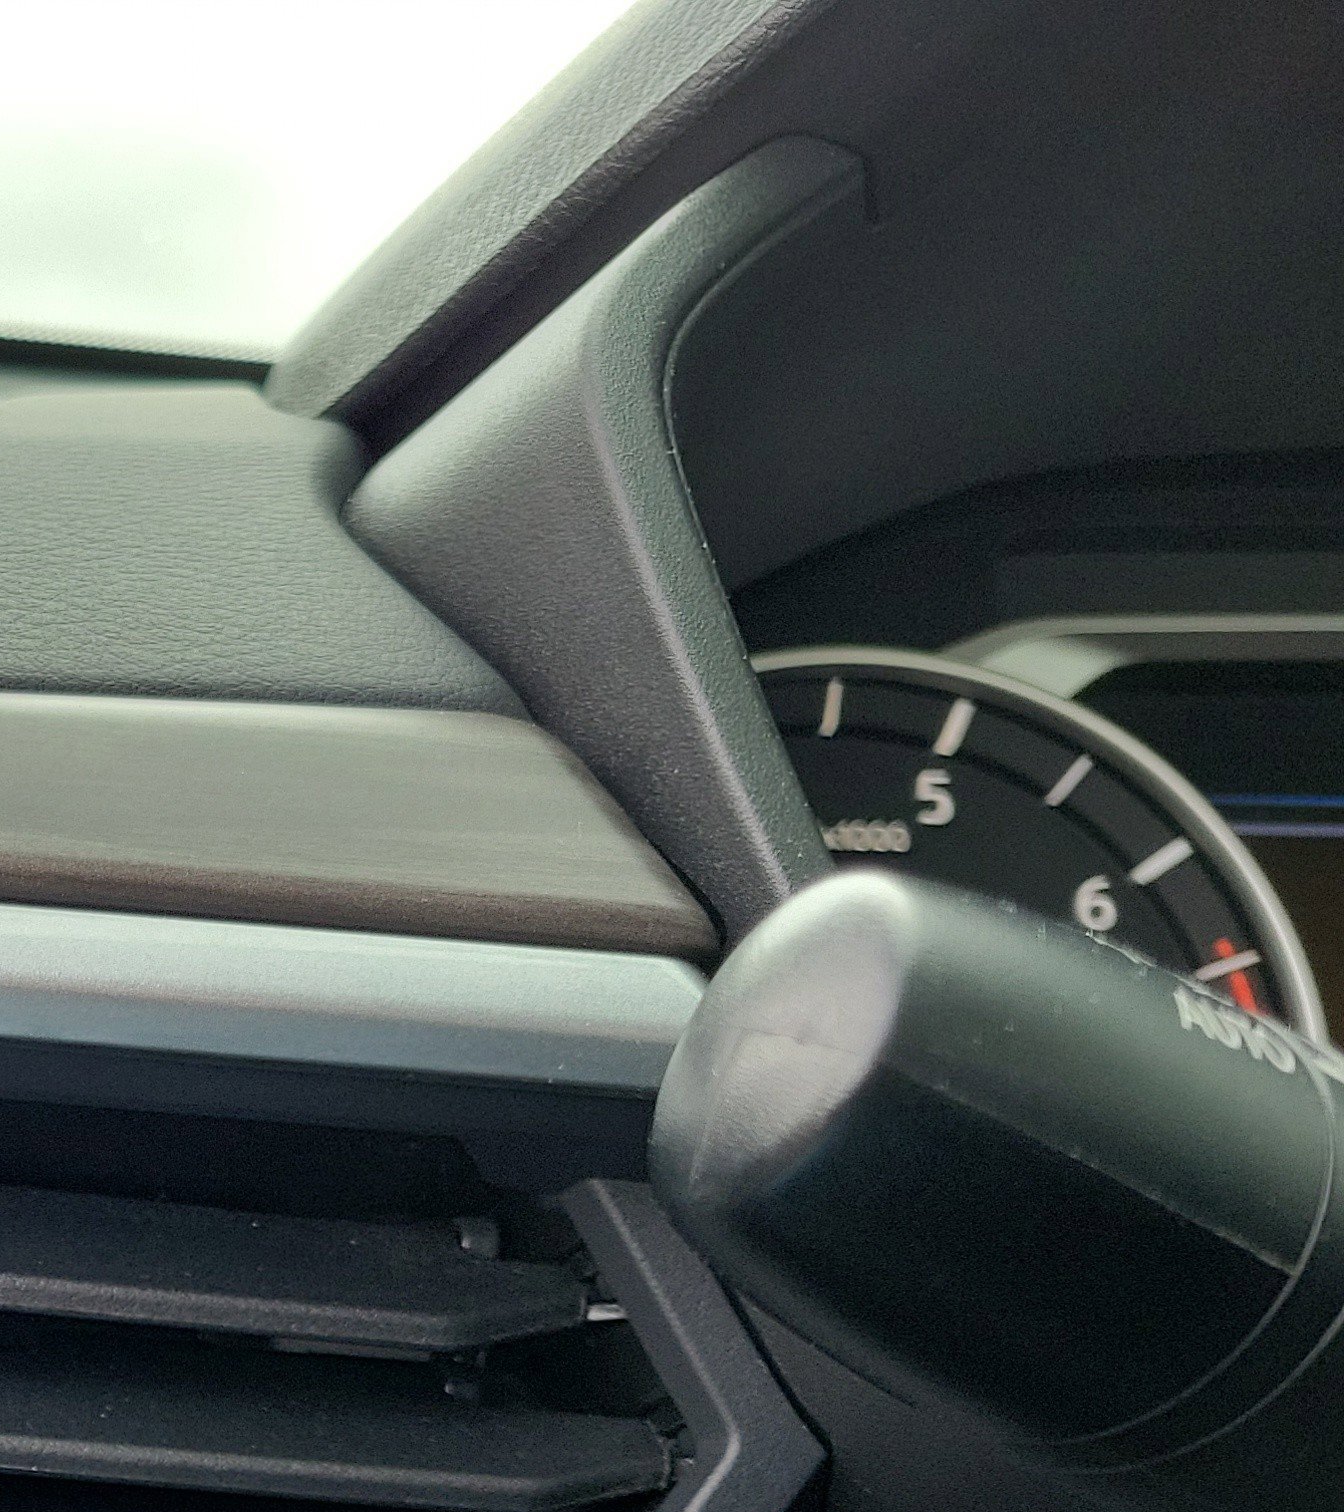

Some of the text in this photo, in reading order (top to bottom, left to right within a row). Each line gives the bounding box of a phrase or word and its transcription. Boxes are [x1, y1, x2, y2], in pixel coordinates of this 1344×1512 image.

[915, 769, 956, 826] 5
[1074, 875, 1118, 932] 6
[1173, 985, 1296, 1075] AUTO
